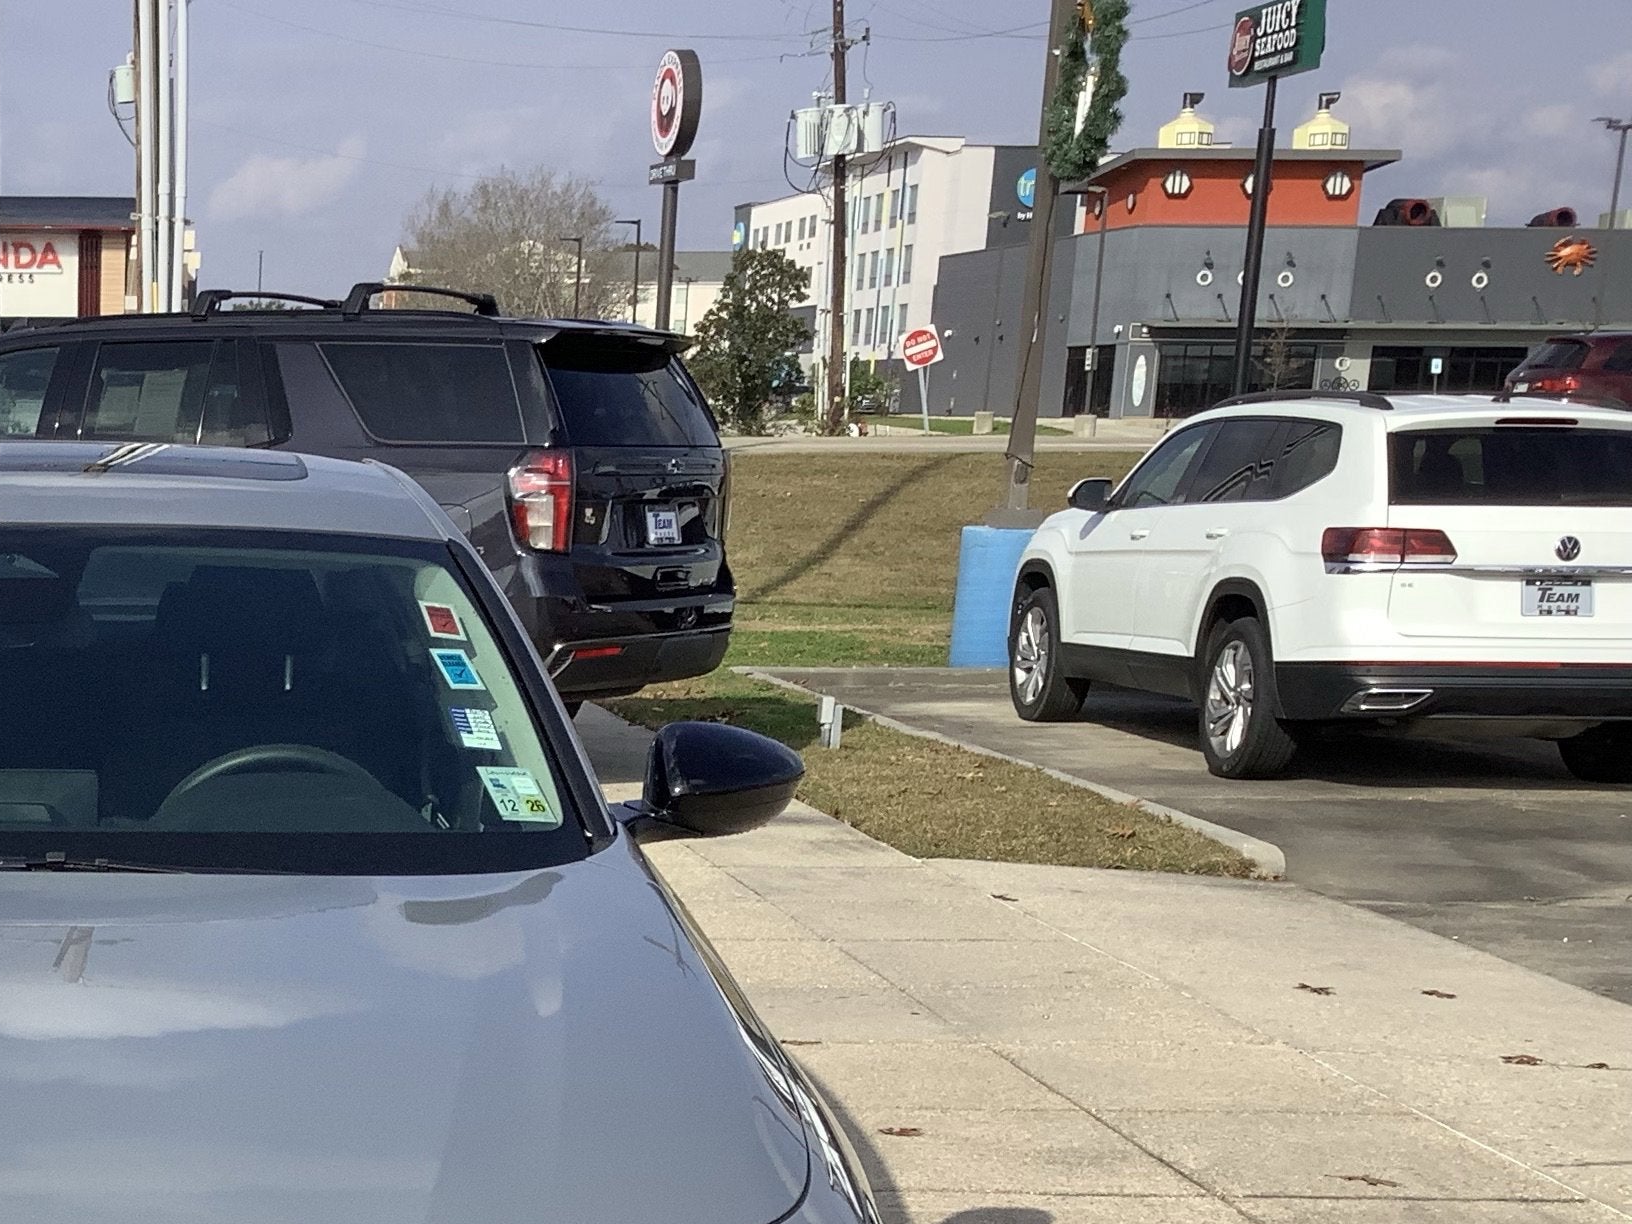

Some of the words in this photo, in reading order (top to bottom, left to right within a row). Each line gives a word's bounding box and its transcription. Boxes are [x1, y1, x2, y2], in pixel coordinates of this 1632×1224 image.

[1256, 0, 1301, 37] JUICY
[1254, 28, 1297, 57] SEAFOOD
[906, 338, 916, 348] DO
[916, 333, 931, 343] NOT
[912, 349, 934, 361] ENTER
[1536, 587, 1581, 603] TEAM
[499, 799, 519, 812] 12
[525, 799, 546, 813] 26
